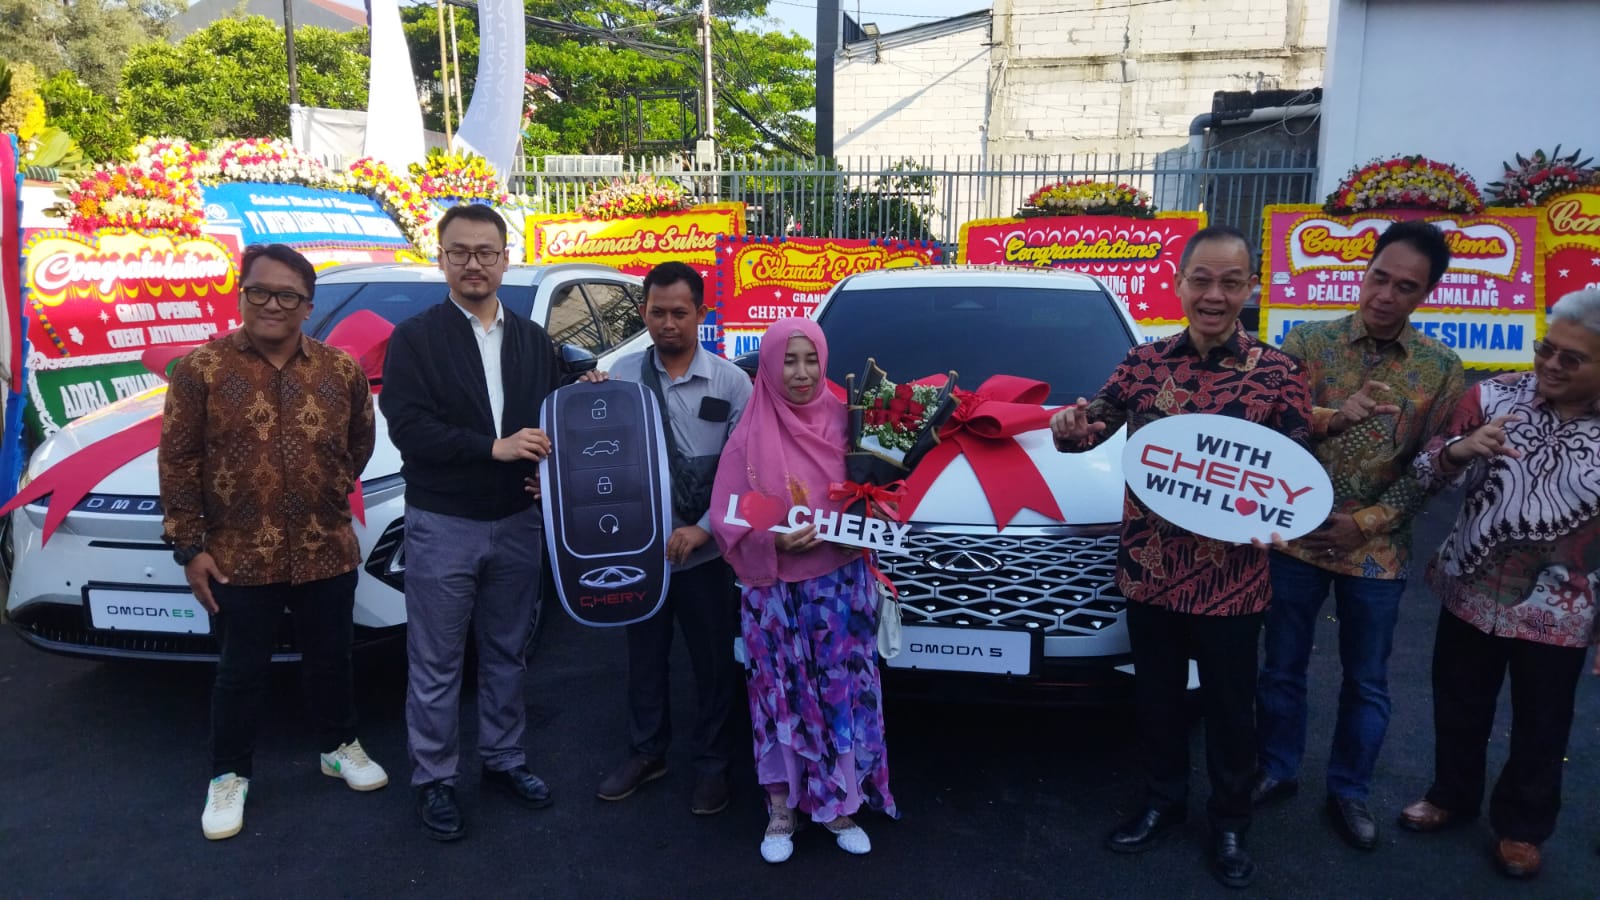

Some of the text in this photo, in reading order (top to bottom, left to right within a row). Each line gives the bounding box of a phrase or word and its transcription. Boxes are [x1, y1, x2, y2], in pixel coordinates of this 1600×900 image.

[551, 225, 717, 255] Selamat & Sukse
[1005, 238, 1161, 266] Congratulations
[755, 253, 826, 281] Selamat
[1332, 270, 1355, 282] FOR
[1130, 275, 1145, 294] OF
[1307, 284, 1360, 302] DEALER
[1196, 433, 1272, 469] WITH
[1140, 444, 1315, 505] CHERY
[1146, 472, 1212, 506] WITH
[787, 504, 912, 550] CHERY
[107, 605, 169, 617] OMODA
[579, 591, 647, 607] CHERY
[909, 643, 984, 657] OMODA
